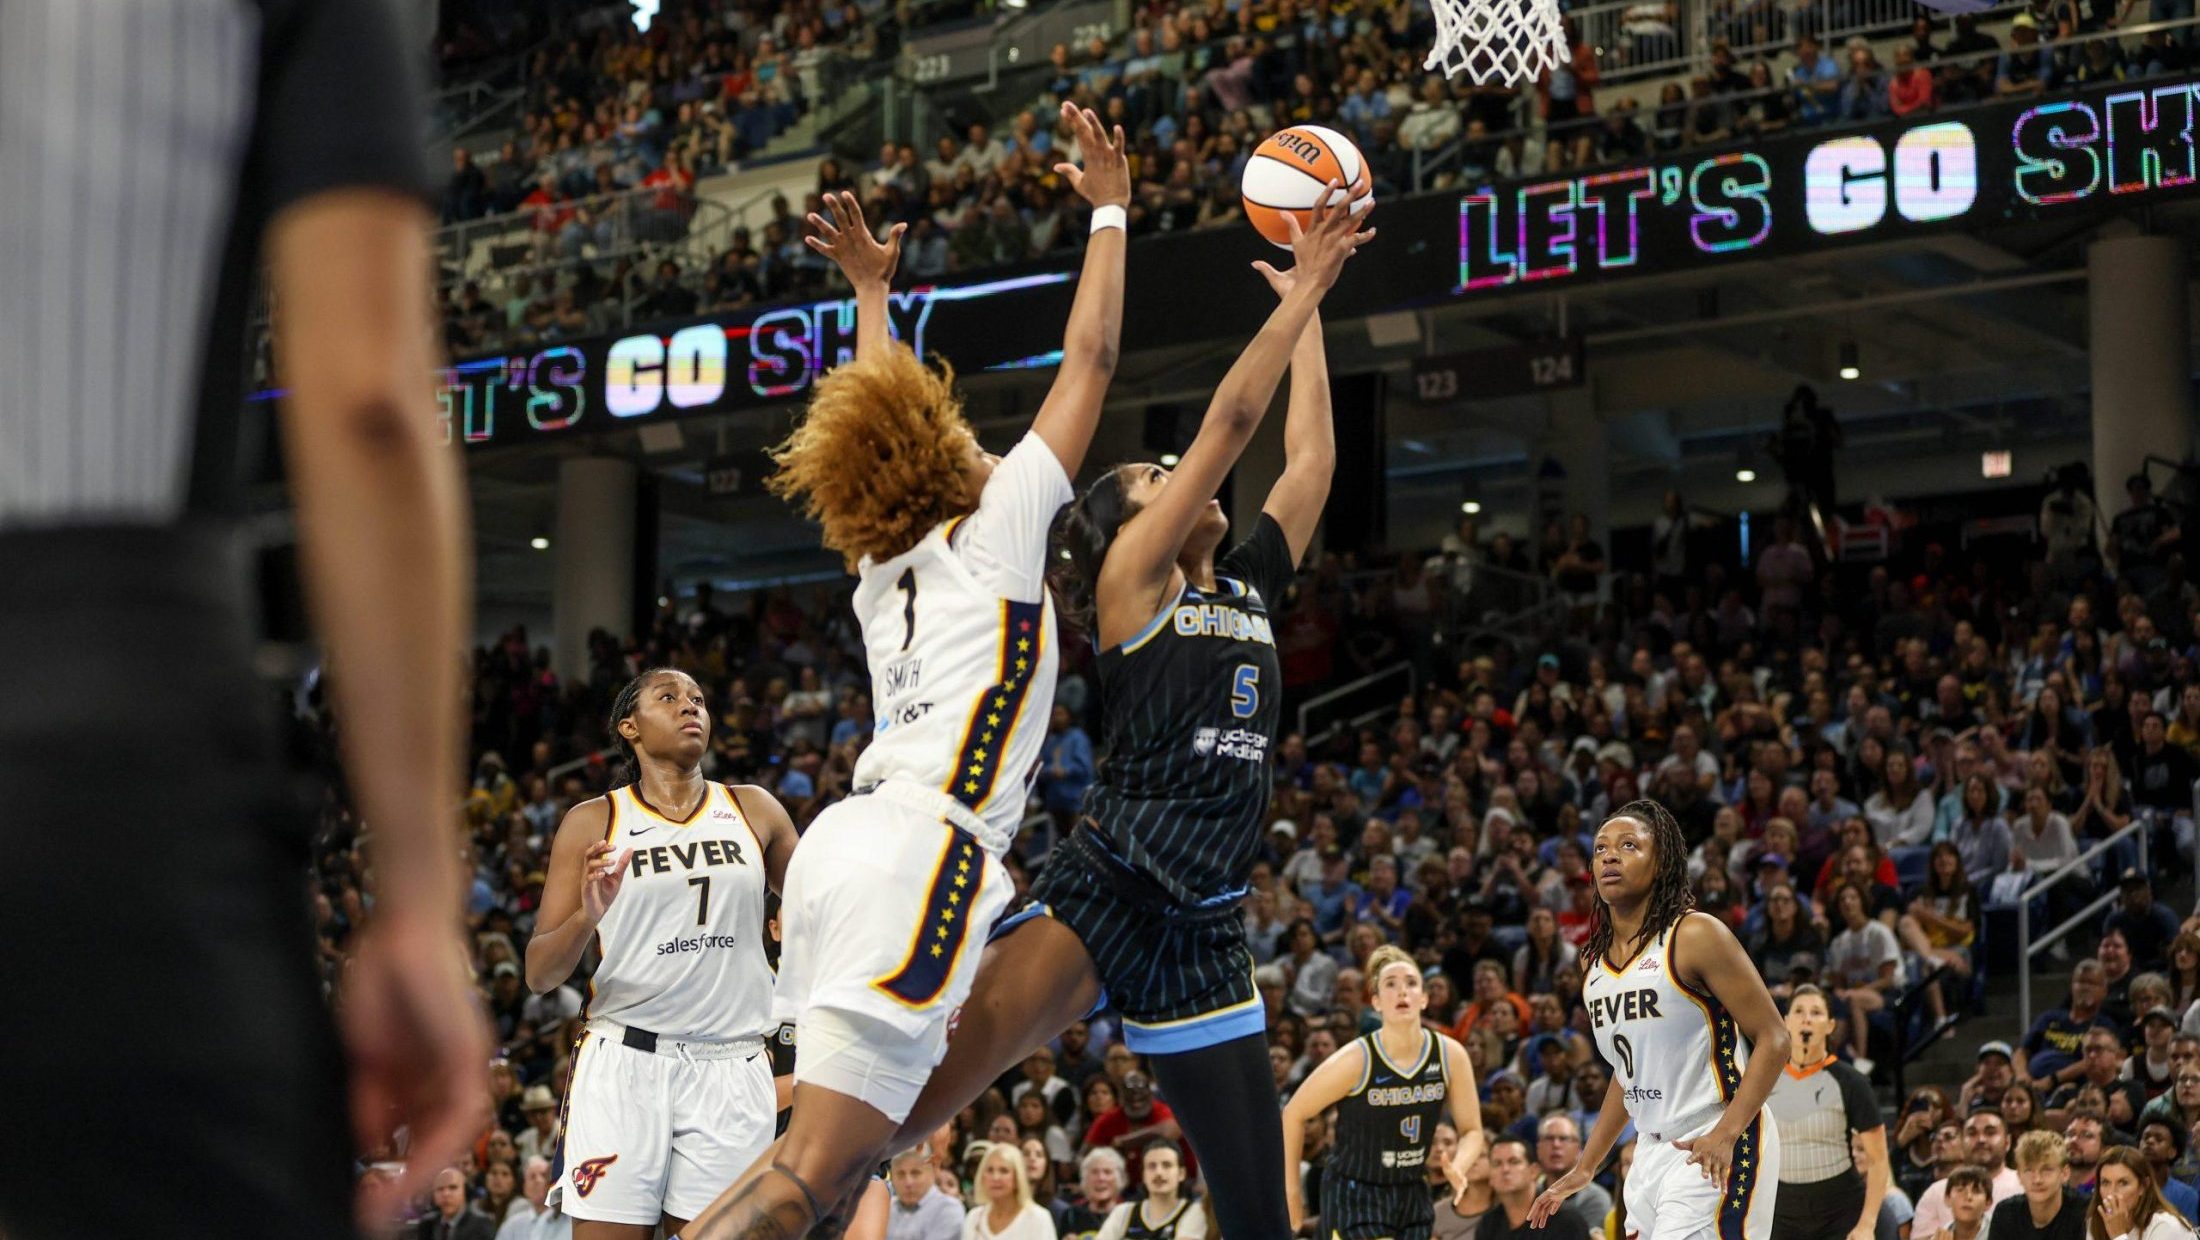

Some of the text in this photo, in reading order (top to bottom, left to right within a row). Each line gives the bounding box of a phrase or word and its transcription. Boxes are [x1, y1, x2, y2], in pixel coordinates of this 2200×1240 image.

[1459, 80, 2200, 289] LET'S GO SK
[605, 323, 728, 417] GO
[1416, 353, 1572, 399] 123 124
[896, 565, 917, 652] 1
[1174, 604, 1277, 650] CHICAG
[1230, 664, 1260, 719] 5
[630, 838, 749, 880] FEVER
[687, 875, 712, 927] 7
[656, 933, 735, 956] salesforce
[1638, 957, 1660, 971] Lilly
[1613, 1033, 1634, 1080] 0
[1367, 1081, 1446, 1107] CHICAGO
[1400, 1114, 1421, 1144] 4
